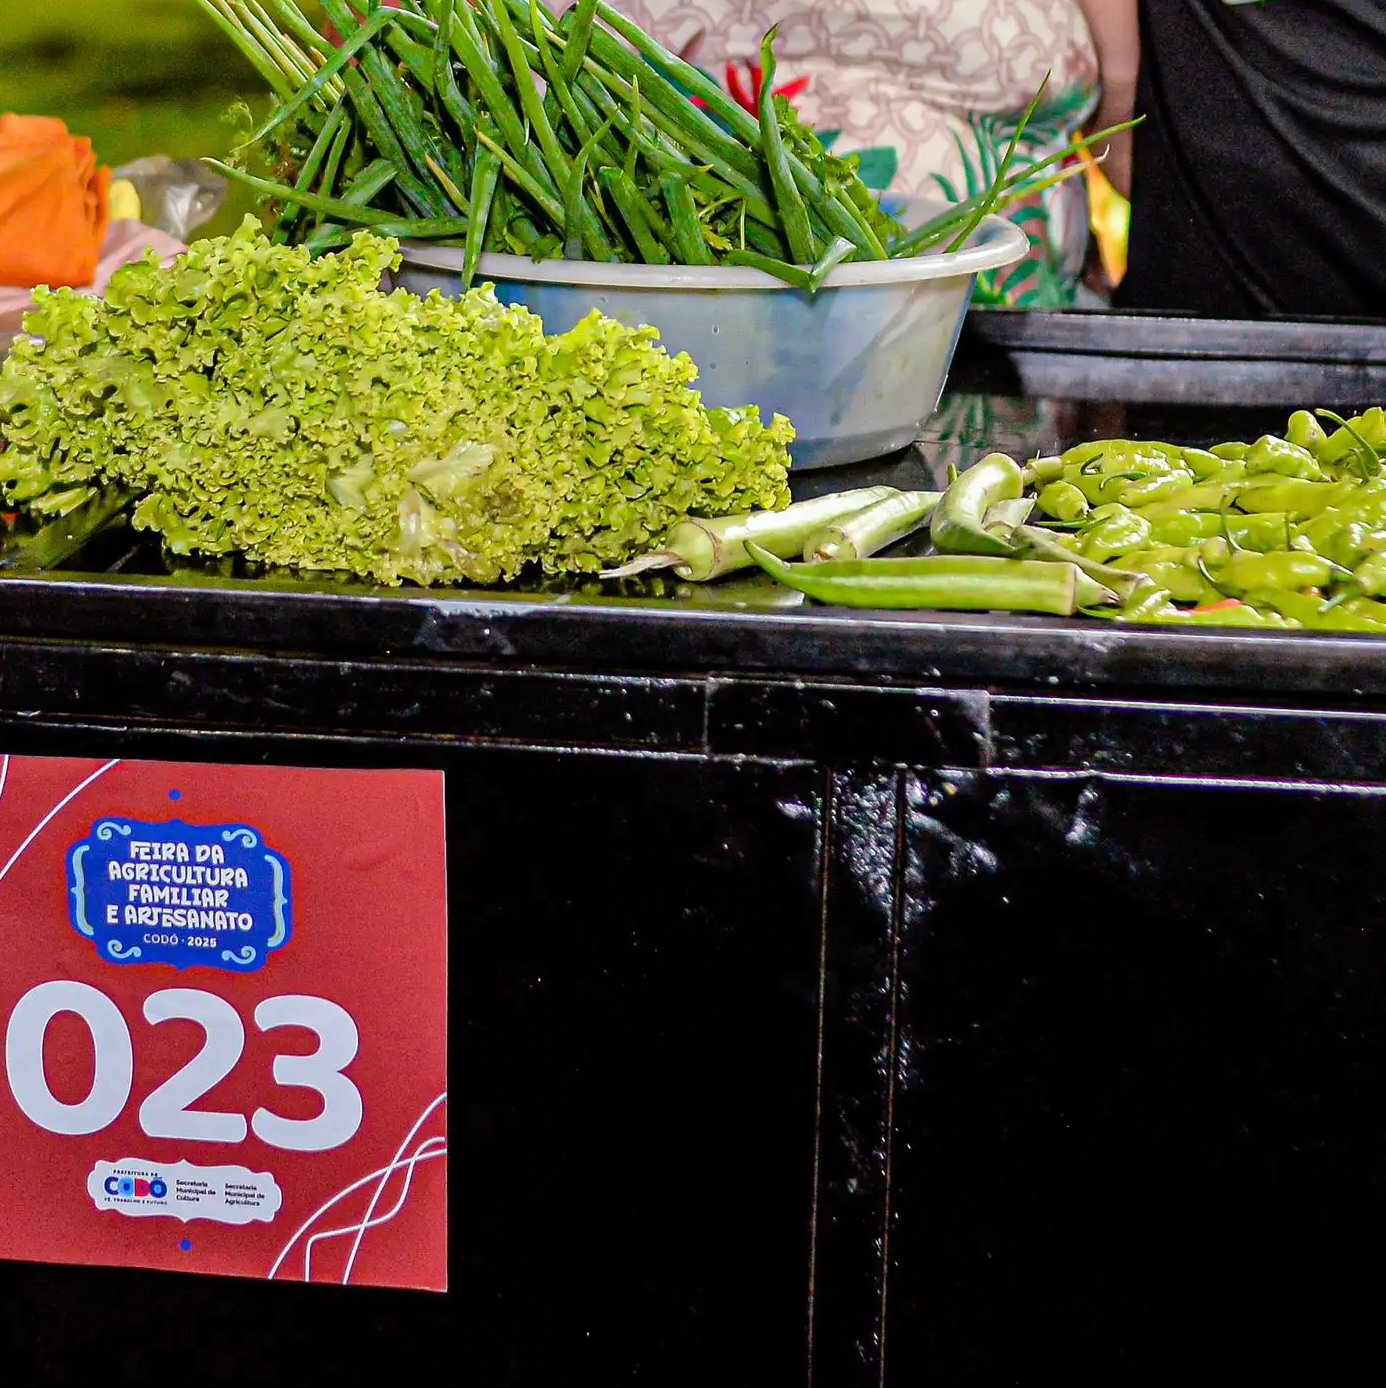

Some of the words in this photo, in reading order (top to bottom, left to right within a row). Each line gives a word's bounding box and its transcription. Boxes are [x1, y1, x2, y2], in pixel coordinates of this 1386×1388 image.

[130, 841, 189, 862] FEIRA
[196, 844, 225, 864] DA
[108, 861, 248, 888] AGRICULTURA
[129, 884, 229, 907] FAMILIAR
[106, 905, 118, 924] E
[124, 905, 253, 931] ARTESANATO
[143, 933, 179, 945] CODÓ
[187, 936, 217, 948] 2025
[5, 979, 363, 1152] 023
[176, 1187, 206, 1195] Municipal
[225, 1183, 257, 1191] Secretaria
[225, 1198, 260, 1206] Agricultura
